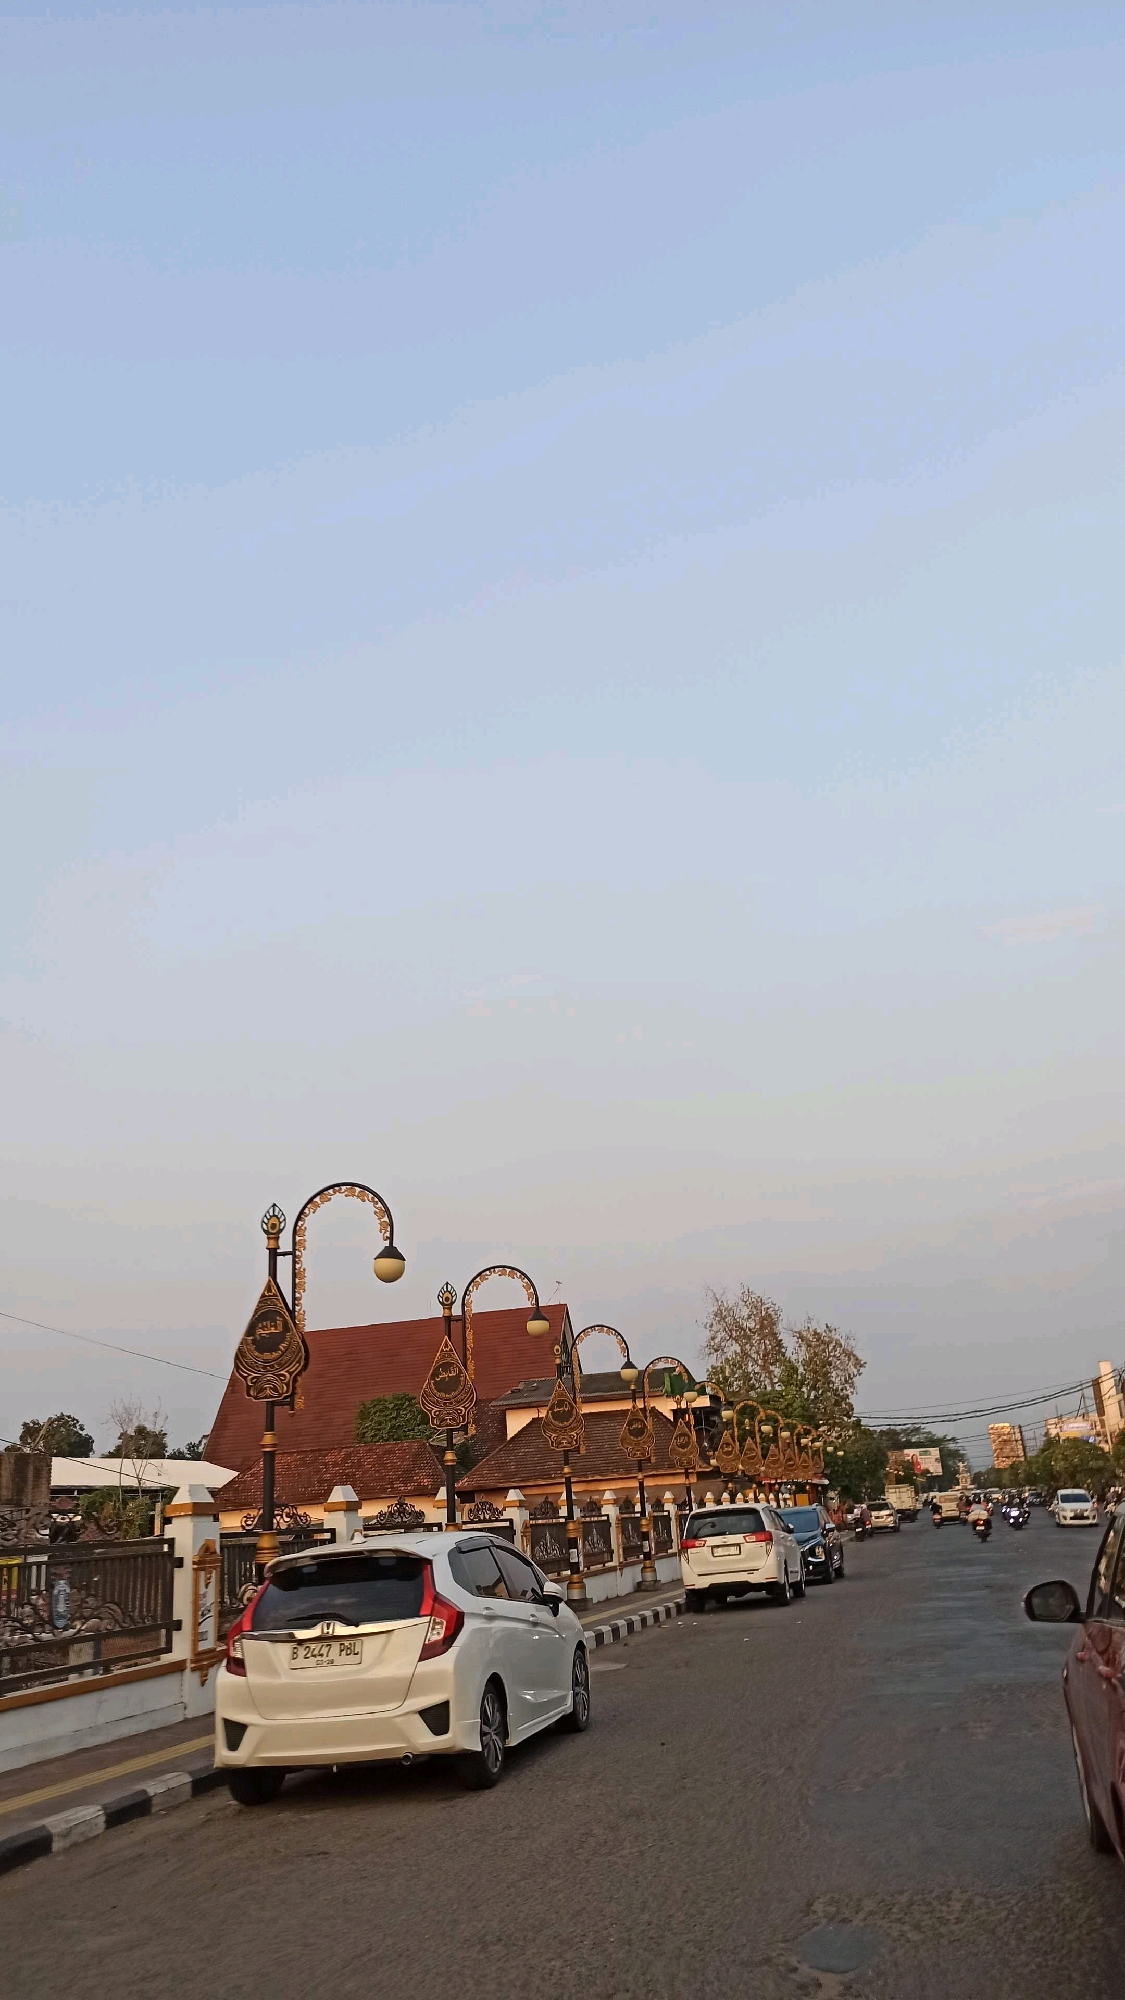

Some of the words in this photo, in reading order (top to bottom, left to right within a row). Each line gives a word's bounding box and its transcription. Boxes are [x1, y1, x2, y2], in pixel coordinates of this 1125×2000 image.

[291, 1646, 299, 1660] B
[303, 1644, 333, 1659] 2447
[338, 1642, 360, 1656] PBL
